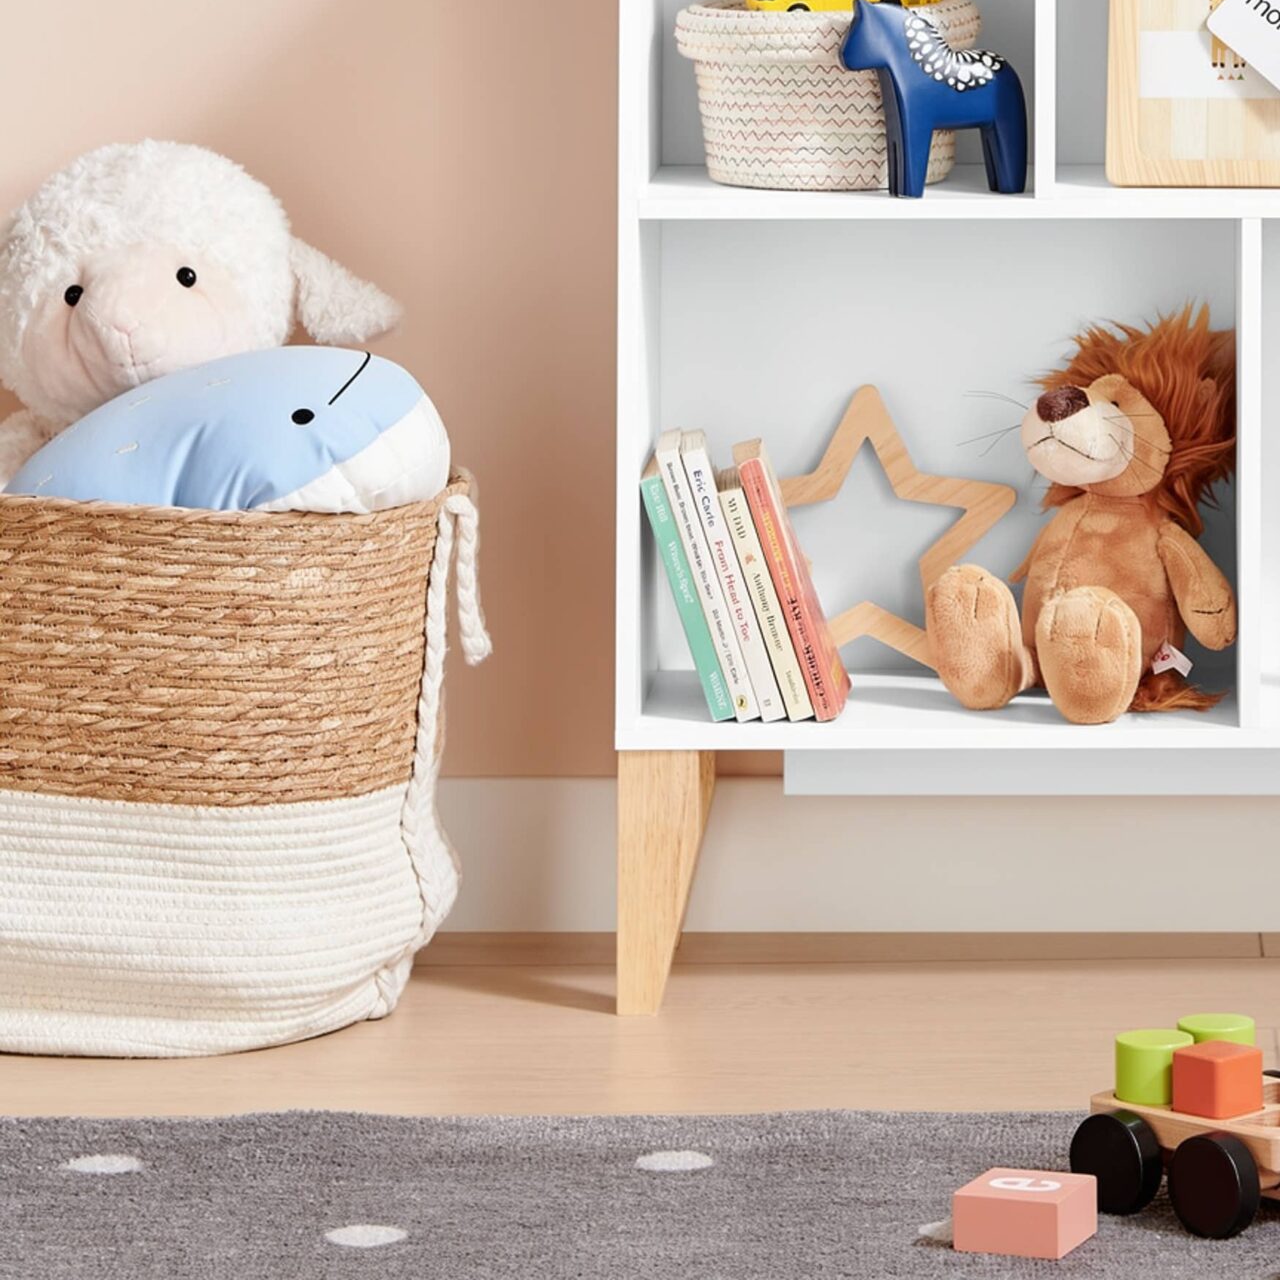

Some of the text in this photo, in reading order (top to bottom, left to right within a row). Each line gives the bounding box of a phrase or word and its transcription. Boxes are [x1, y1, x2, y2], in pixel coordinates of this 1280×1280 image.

[692, 469, 705, 492] Eric
[700, 494, 714, 527] Carle
[714, 539, 728, 572] From
[724, 573, 740, 605] Head
[734, 607, 743, 620] to
